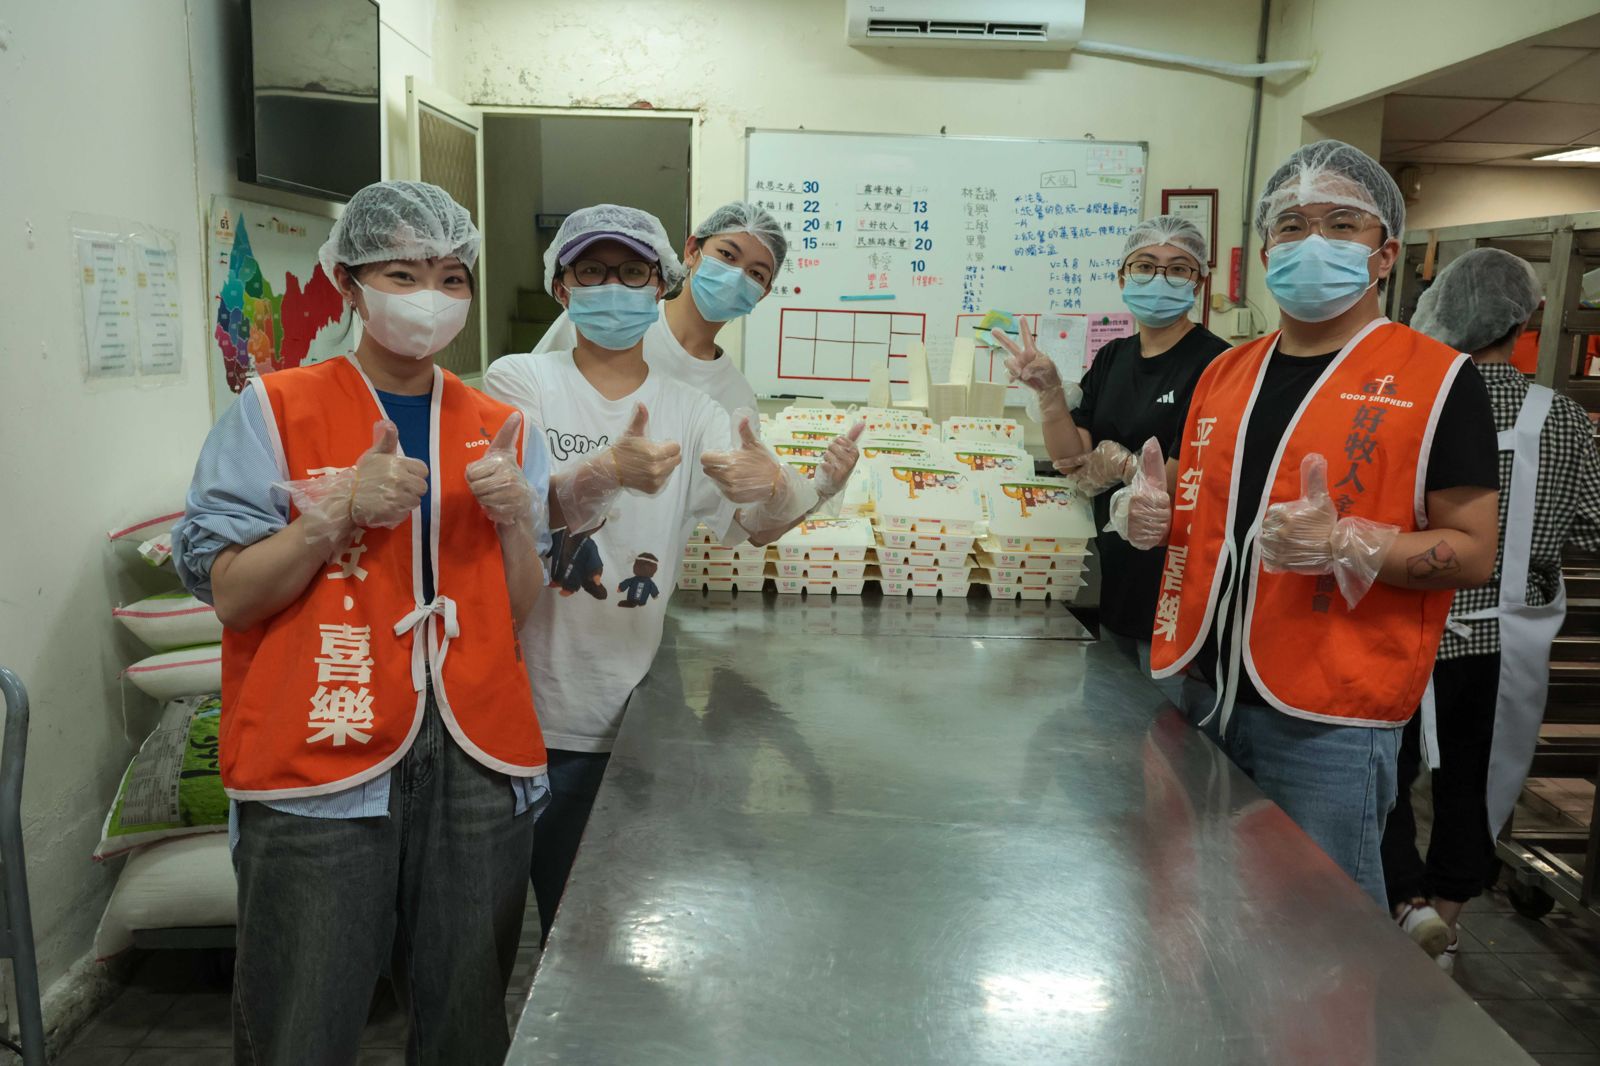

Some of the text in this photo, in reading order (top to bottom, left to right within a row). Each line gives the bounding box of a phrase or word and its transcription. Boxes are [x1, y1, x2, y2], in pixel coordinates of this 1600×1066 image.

[803, 181, 819, 193] 30
[803, 200, 820, 212] 22
[912, 201, 928, 213] 13
[802, 218, 820, 232] 20
[836, 220, 842, 232] 1
[913, 220, 929, 232] 14
[802, 237, 817, 249] 15
[914, 238, 933, 251] 20
[911, 260, 926, 272] 10
[1340, 392, 1414, 408] GOOD SHEPHERD
